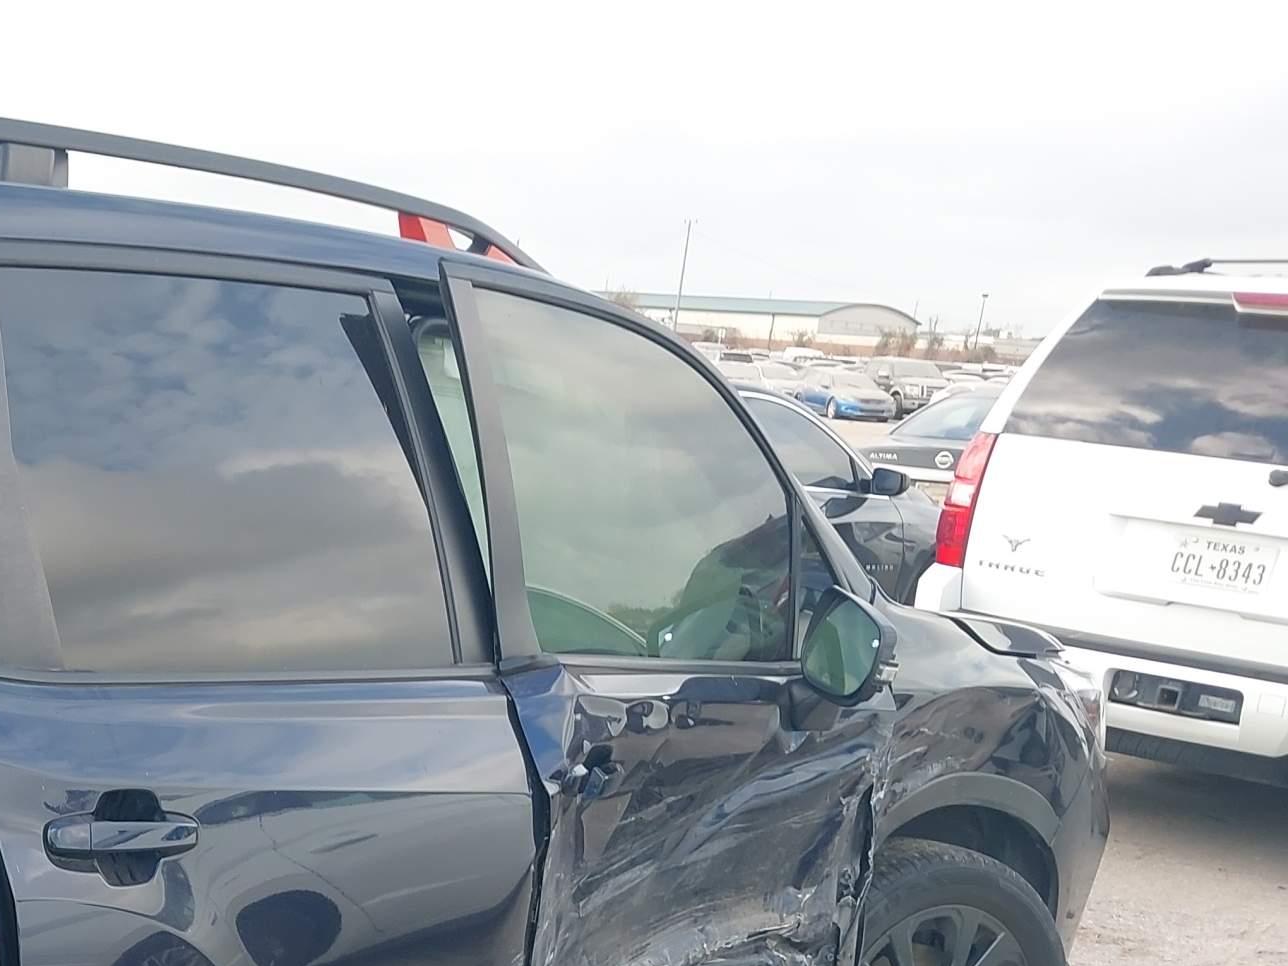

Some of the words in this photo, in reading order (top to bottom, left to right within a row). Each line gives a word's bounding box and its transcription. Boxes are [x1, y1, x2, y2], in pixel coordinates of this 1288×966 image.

[870, 452, 898, 461] ALTIMA
[1206, 540, 1246, 555] TEXAS
[1216, 558, 1266, 586] 8343
